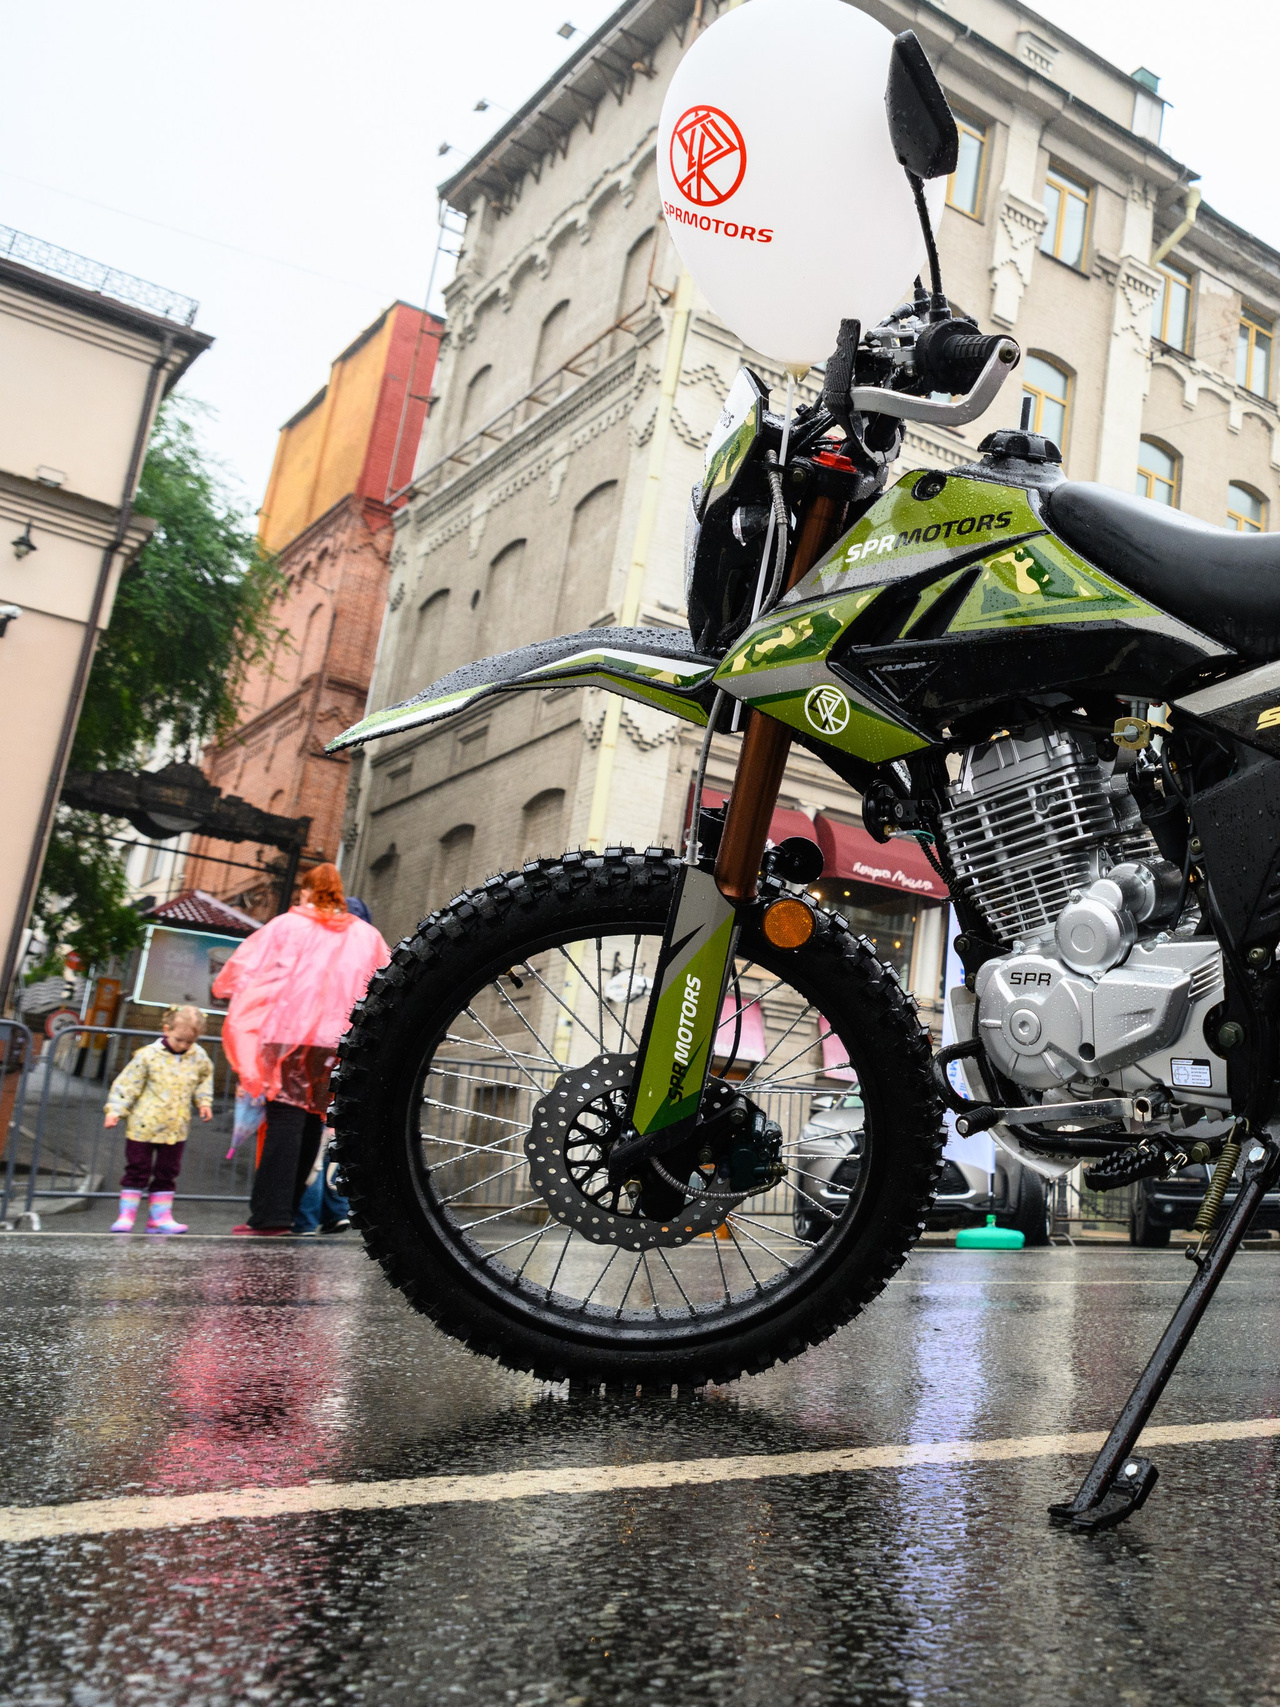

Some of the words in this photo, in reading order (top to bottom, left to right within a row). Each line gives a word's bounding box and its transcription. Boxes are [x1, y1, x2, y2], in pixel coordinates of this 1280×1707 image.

[664, 201, 774, 243] SPRMOTORS
[845, 511, 1013, 563] SPRMOTORS
[1009, 972, 1052, 986] SPR
[667, 973, 701, 1103] SPRMOTORS
